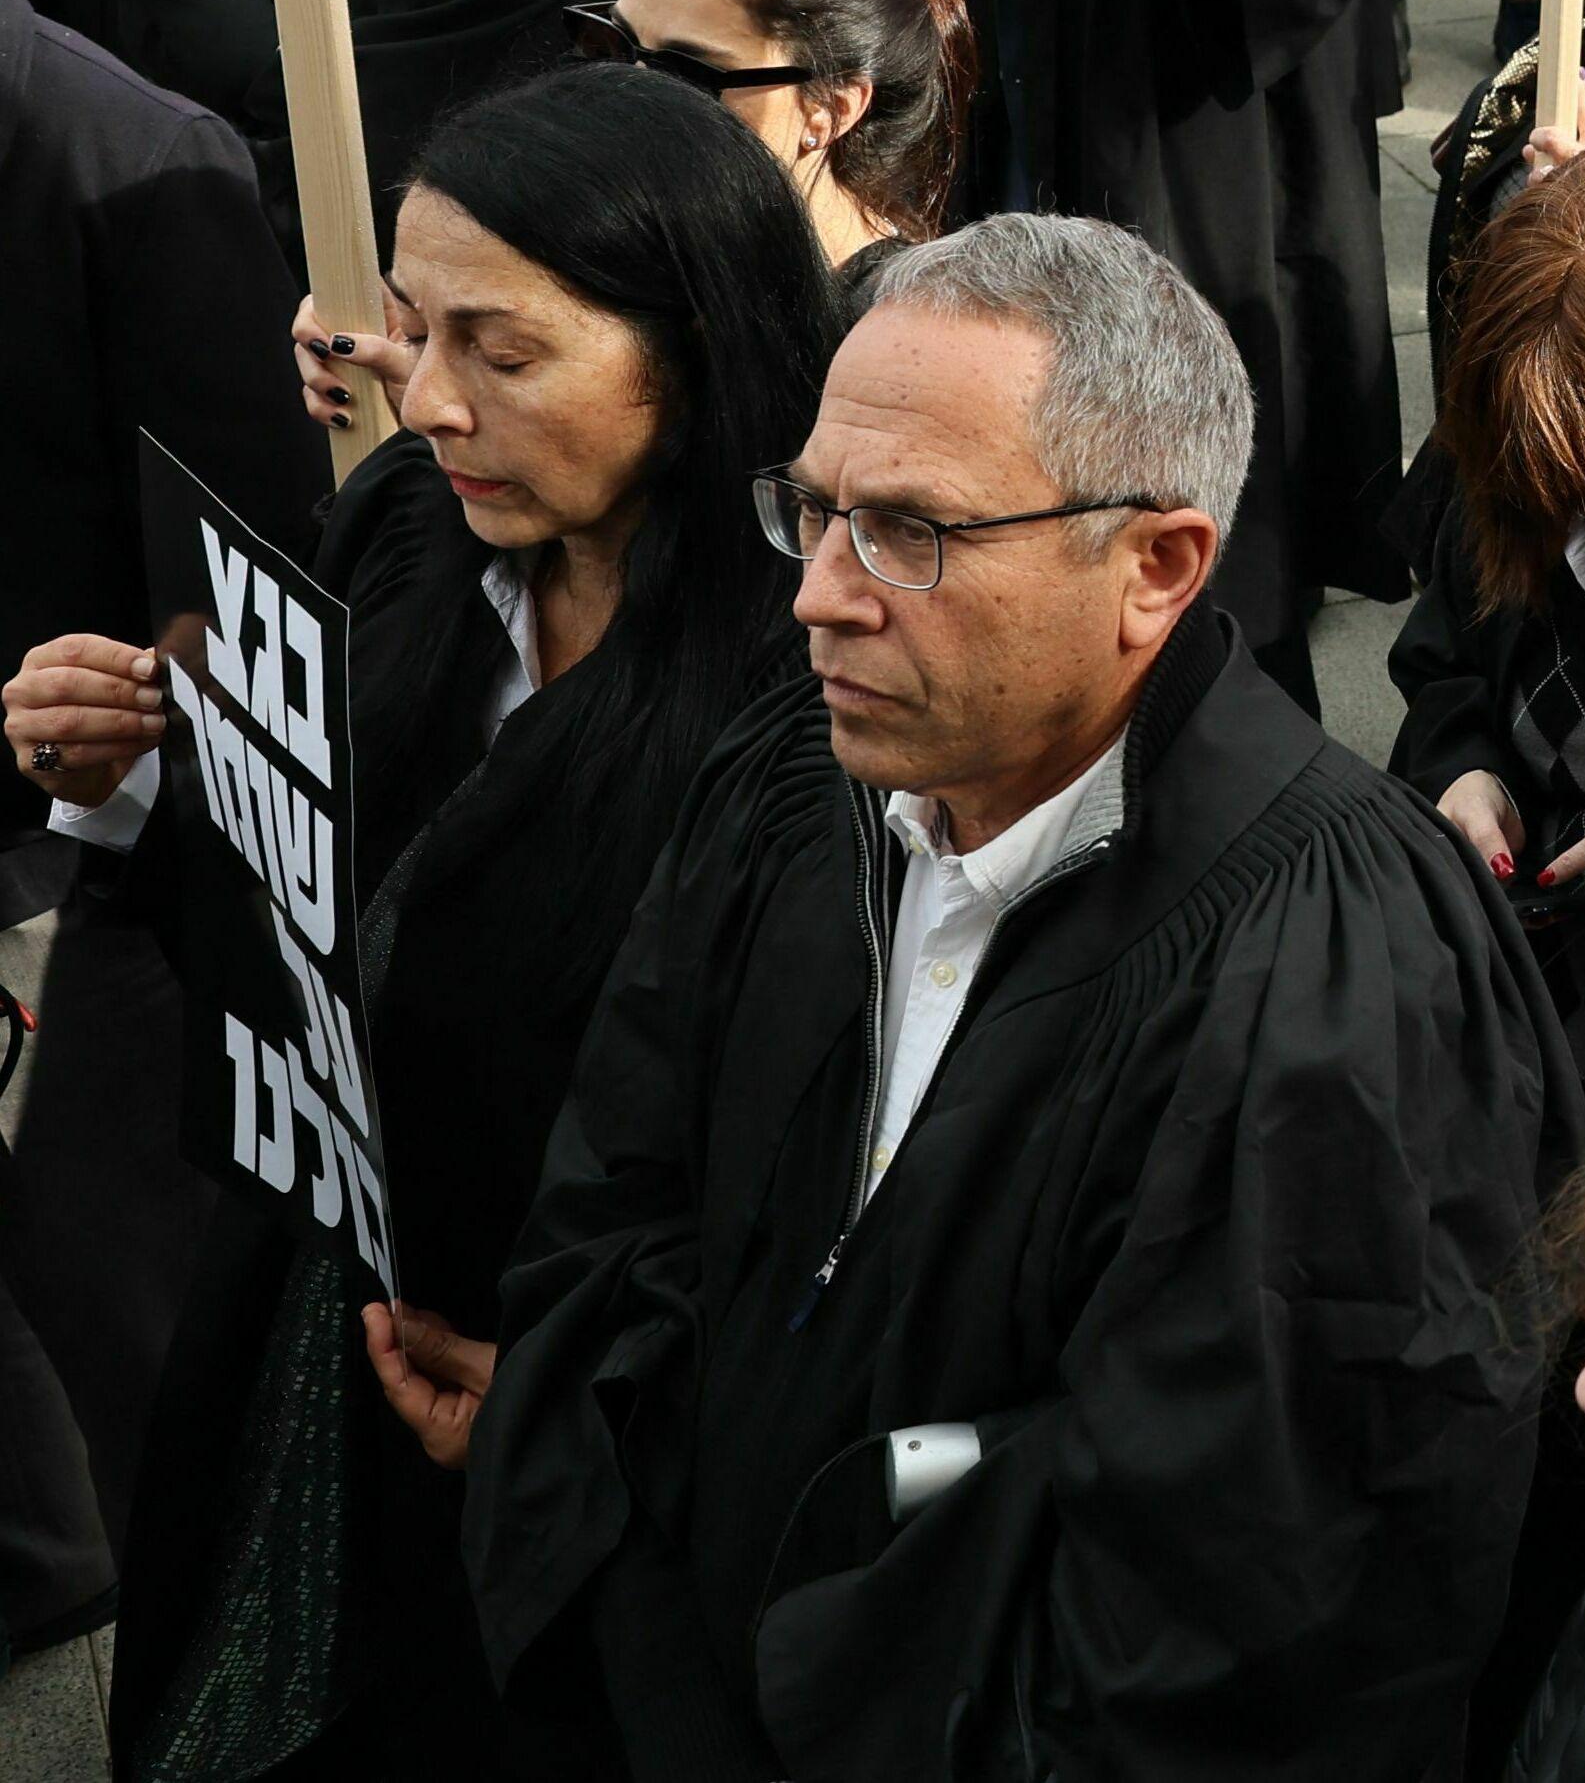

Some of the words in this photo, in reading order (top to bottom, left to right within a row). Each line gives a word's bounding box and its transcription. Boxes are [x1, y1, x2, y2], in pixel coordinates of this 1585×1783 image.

[168, 655, 335, 956] שומר
[225, 1011, 397, 1315] כולנו
[269, 900, 369, 1139] על
